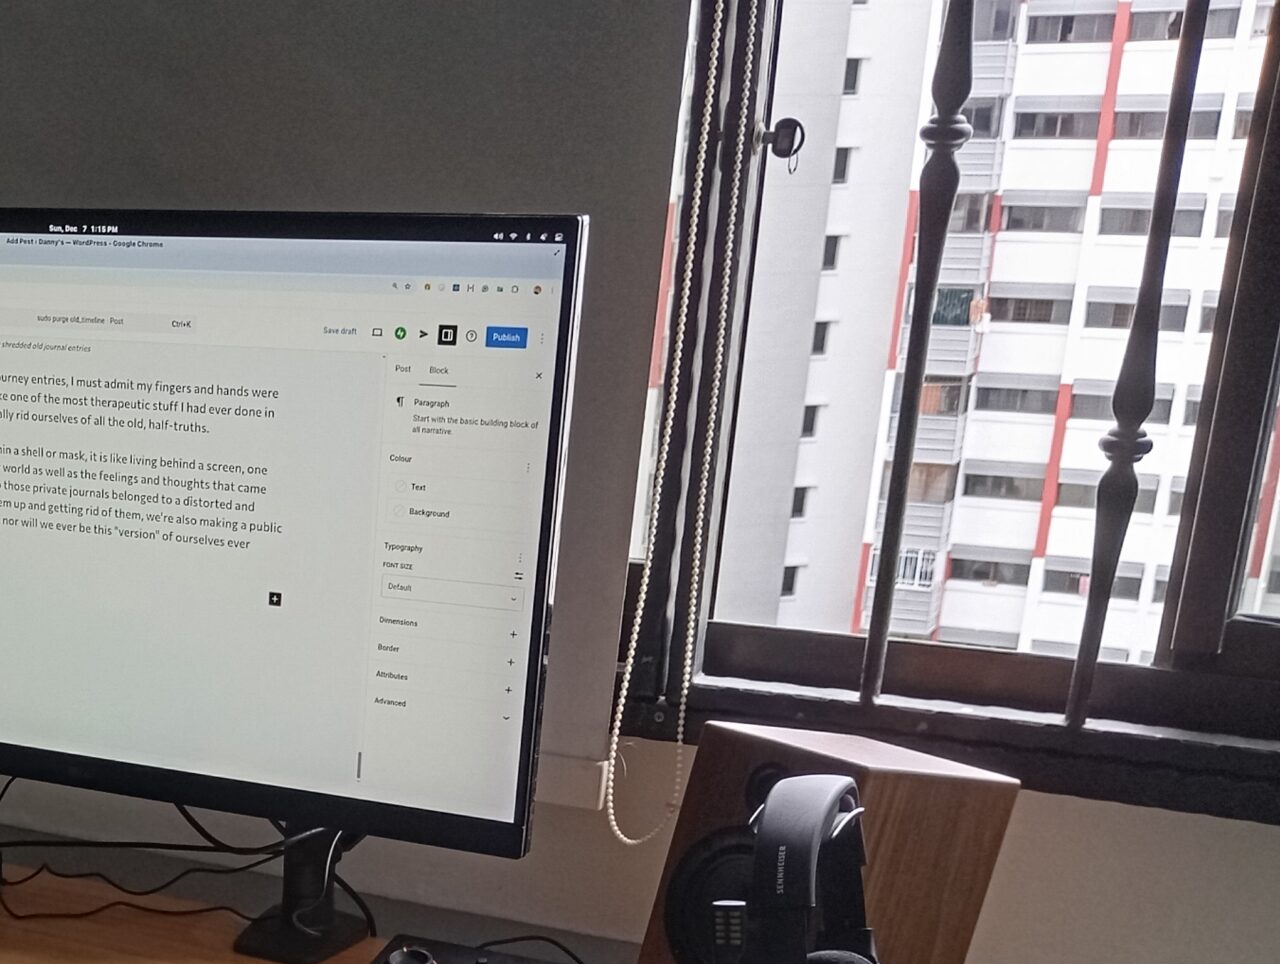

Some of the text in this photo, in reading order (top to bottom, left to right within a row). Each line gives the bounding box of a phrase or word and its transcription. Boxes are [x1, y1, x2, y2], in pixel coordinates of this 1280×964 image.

[49, 224, 63, 233] Sun,
[64, 225, 78, 233] Dec
[82, 225, 88, 233] 7
[90, 225, 107, 233] 1:15
[20, 238, 34, 246] Post
[38, 238, 65, 247] Danny's
[72, 239, 108, 247] WordPress
[113, 240, 136, 248] Google
[137, 240, 164, 248] Chrome
[37, 315, 51, 323] sudo
[52, 316, 69, 325] purge
[109, 317, 124, 325] Post
[171, 320, 192, 329] Ctrl+K
[322, 326, 357, 337] Save draft
[492, 331, 520, 343] Publish
[1, 340, 32, 350] shredded
[31, 341, 44, 352] old
[42, 342, 68, 352] journal
[66, 343, 92, 353] entries
[395, 364, 412, 374] Post
[429, 366, 449, 375] Block
[30, 374, 69, 389] entries,
[75, 377, 103, 389] must
[103, 377, 135, 391] admit
[136, 382, 153, 394] my
[154, 380, 192, 396] fingers
[193, 383, 214, 395] and
[216, 383, 249, 397] hands
[250, 388, 279, 399] were
[413, 398, 450, 409] Paragraph
[413, 414, 539, 430] Start with the basic building block of
[412, 426, 421, 434] all
[389, 454, 412, 464] Colour
[2, 463, 31, 475] world
[32, 467, 44, 476] as
[44, 466, 65, 478] well
[66, 469, 78, 479] as
[79, 468, 98, 481] the
[98, 469, 139, 486] feelings
[140, 474, 160, 486] and
[161, 475, 211, 492] thoughts
[211, 479, 236, 492] that
[237, 484, 267, 495] came
[411, 482, 426, 492] Text
[2, 479, 31, 493] those
[32, 482, 68, 496] private
[68, 484, 110, 500] journals
[111, 488, 159, 506] belonged
[160, 493, 173, 505] to
[174, 497, 181, 506] a
[182, 495, 233, 511] distorted
[234, 500, 255, 512] and
[409, 507, 450, 519] Background
[1, 517, 19, 526] nor
[20, 516, 38, 528] will
[39, 520, 54, 530] we
[55, 522, 78, 532] ever
[78, 521, 92, 534] be
[93, 523, 113, 536] this
[113, 525, 160, 540] "version"
[161, 530, 174, 542] of
[175, 534, 225, 547] ourselves
[226, 539, 251, 549] ever
[384, 542, 423, 554] Typography
[382, 561, 413, 571] FONT SIZE
[388, 582, 412, 593] Default
[379, 616, 418, 628] Dimensions
[377, 643, 400, 654] Border
[376, 669, 408, 681] Attributes
[374, 697, 407, 708] Advanced
[775, 845, 787, 895] SENNHEISER
